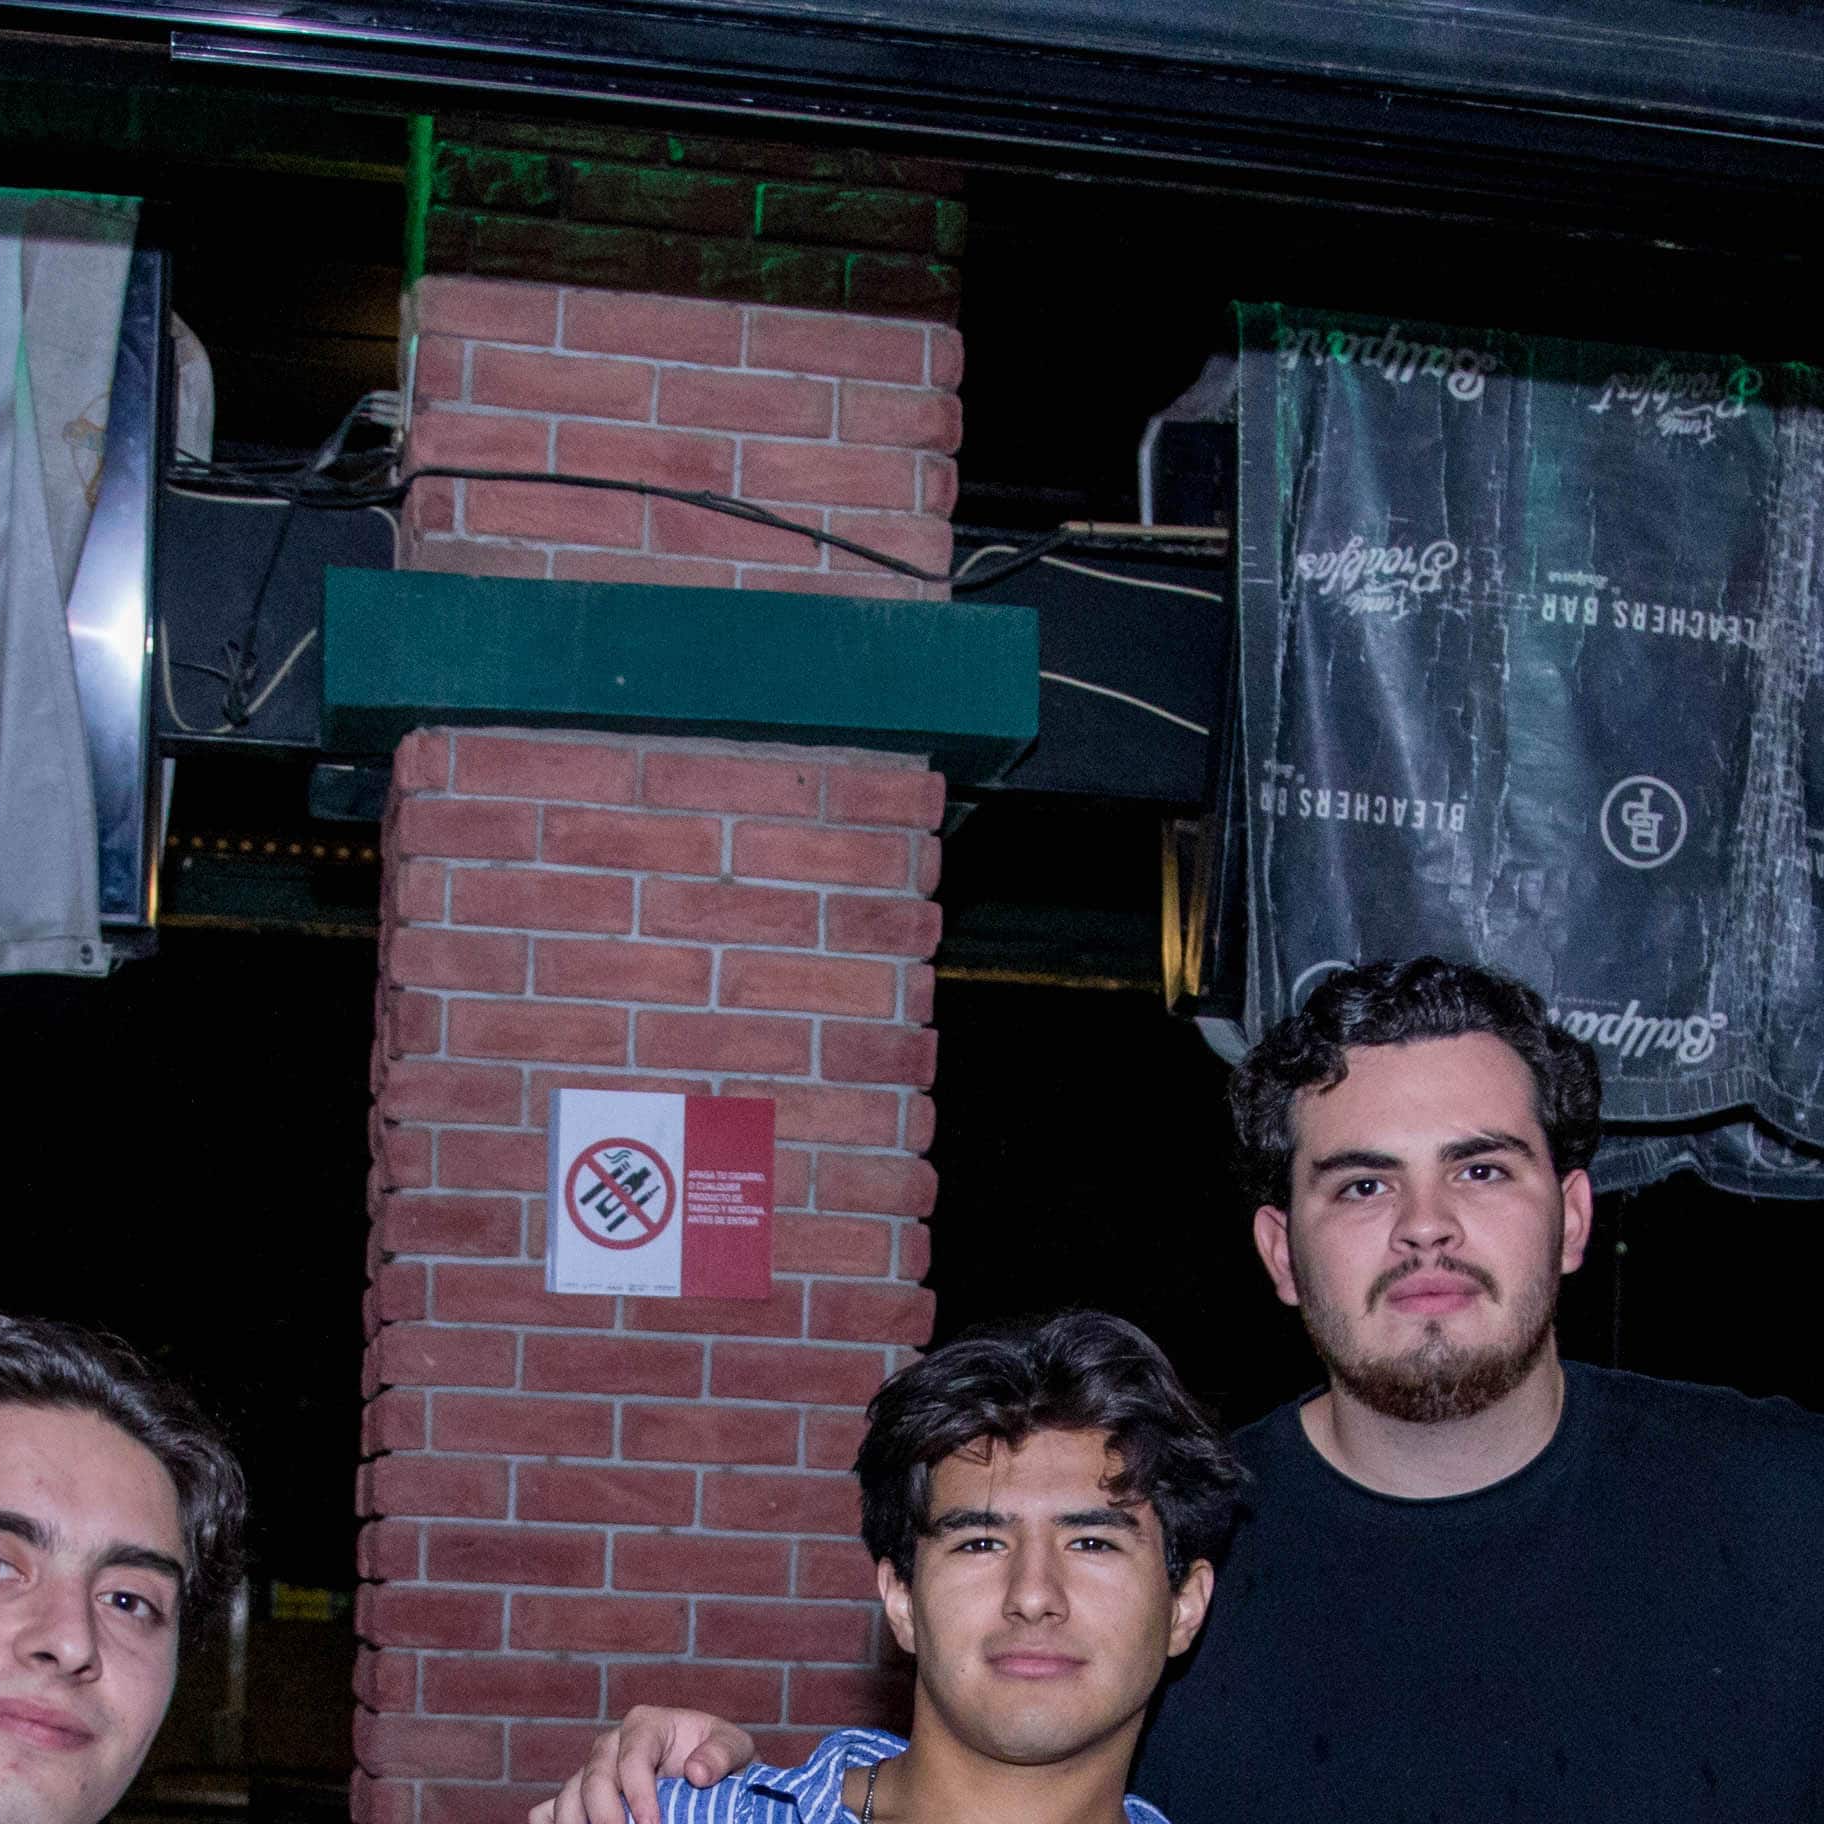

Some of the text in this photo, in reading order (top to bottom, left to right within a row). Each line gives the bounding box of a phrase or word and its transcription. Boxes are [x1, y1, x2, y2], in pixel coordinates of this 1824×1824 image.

[1274, 324, 1498, 400] Ballpark
[1297, 536, 1458, 595] Breakfas
[1541, 593, 1764, 650] LEACHERS BAR
[1299, 788, 1466, 832] BLEACHERS
